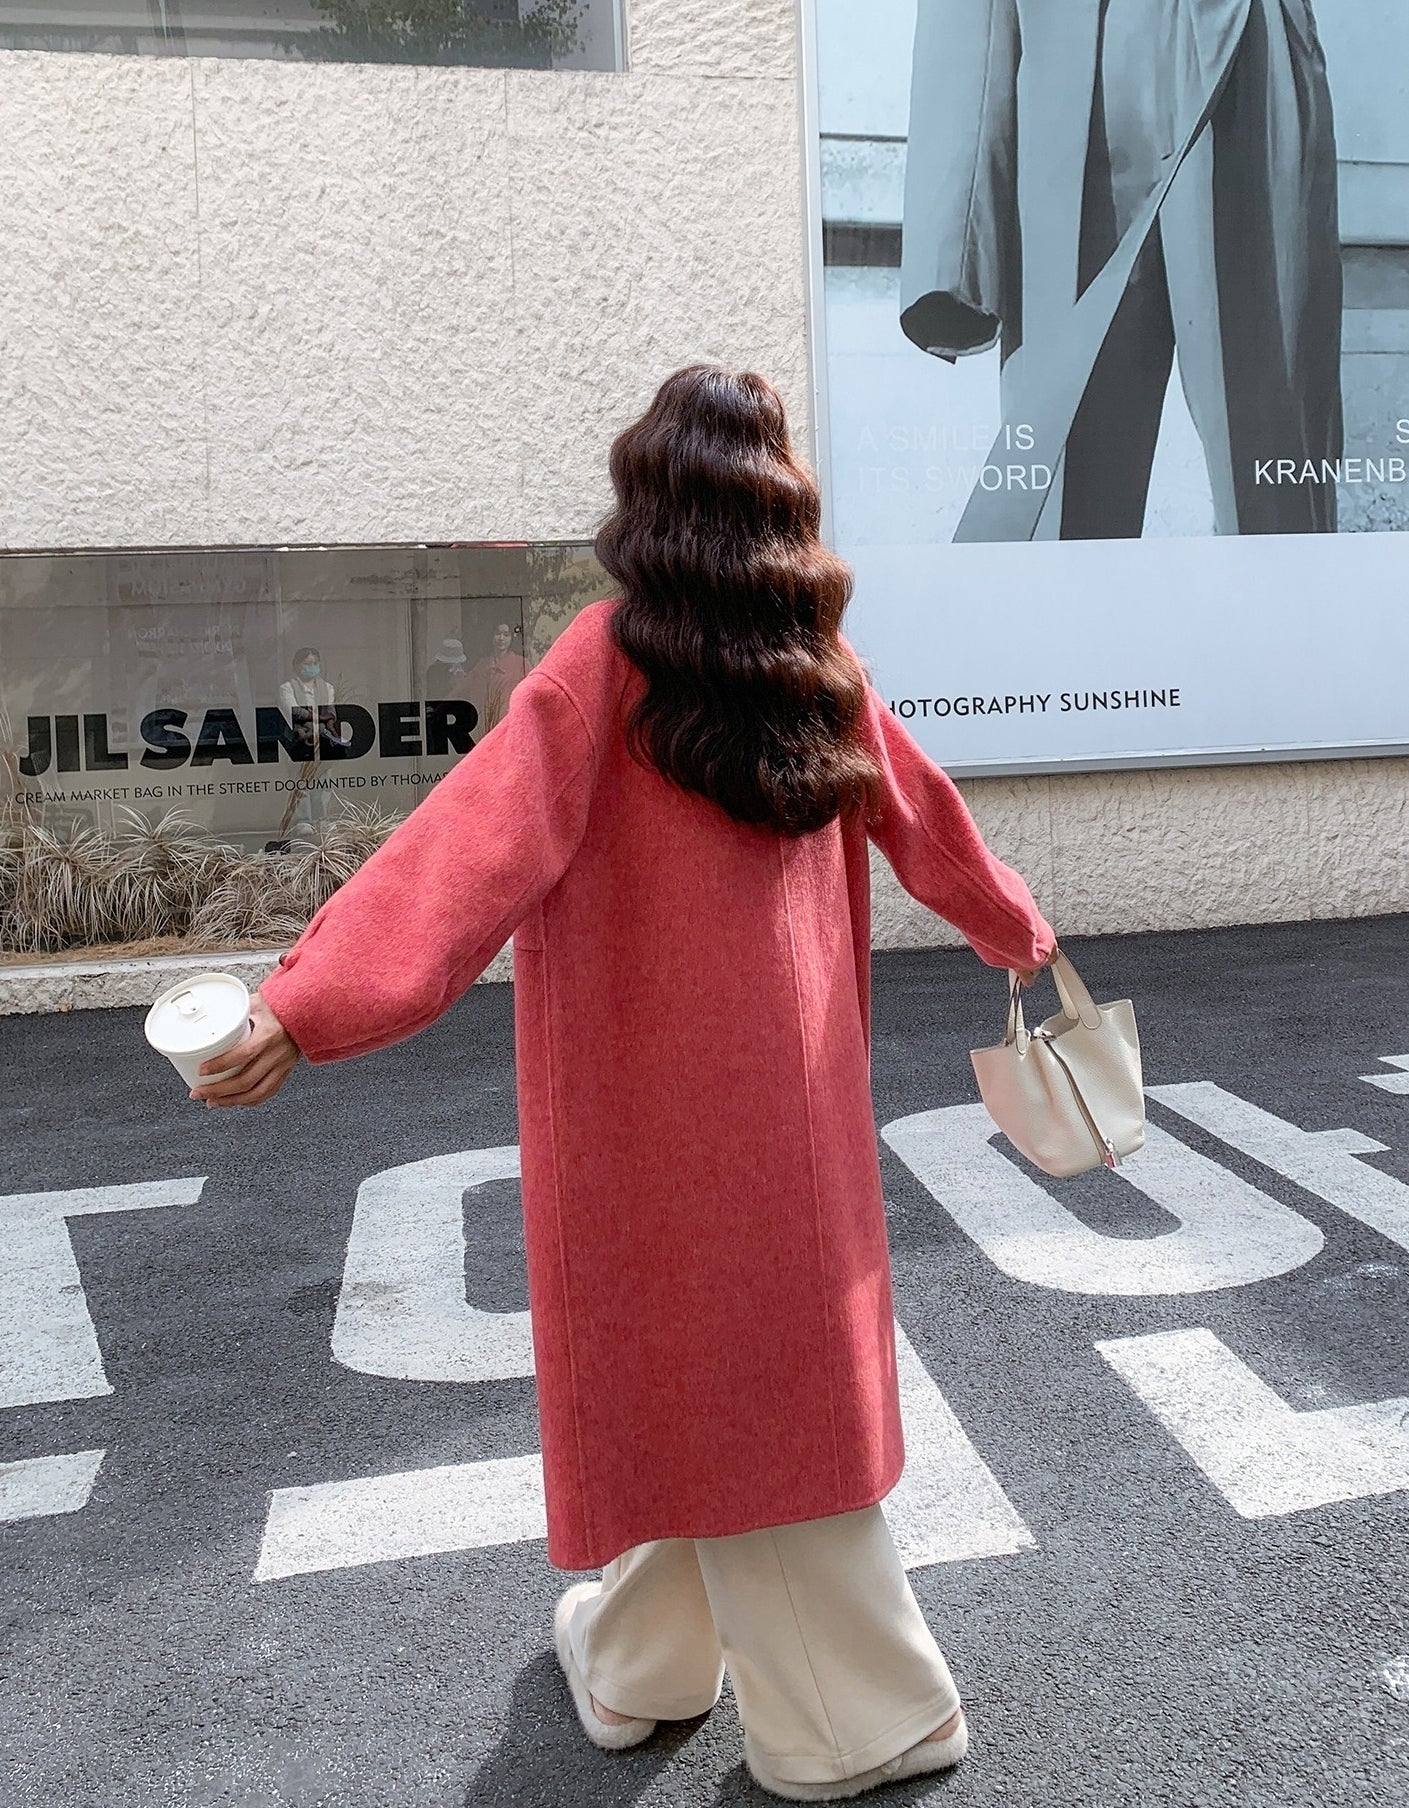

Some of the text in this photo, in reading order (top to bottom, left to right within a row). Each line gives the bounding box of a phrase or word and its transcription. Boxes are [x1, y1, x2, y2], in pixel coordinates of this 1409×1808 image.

[856, 423, 1036, 452] A SMILE IS
[858, 463, 1053, 492] ITS SWORD
[1254, 457, 1407, 485] KRANENB
[889, 688, 1181, 719] OTOGRAPHY SUNSHINE
[19, 700, 479, 777] JIL SANDER
[15, 791, 66, 805] CREAM
[70, 787, 130, 801] MARKET
[134, 785, 163, 799] BAG
[167, 784, 182, 797] IN
[186, 783, 215, 797] THE
[219, 780, 271, 796] STREET
[275, 776, 366, 793] DOCUMNTED
[371, 775, 388, 787] BY
